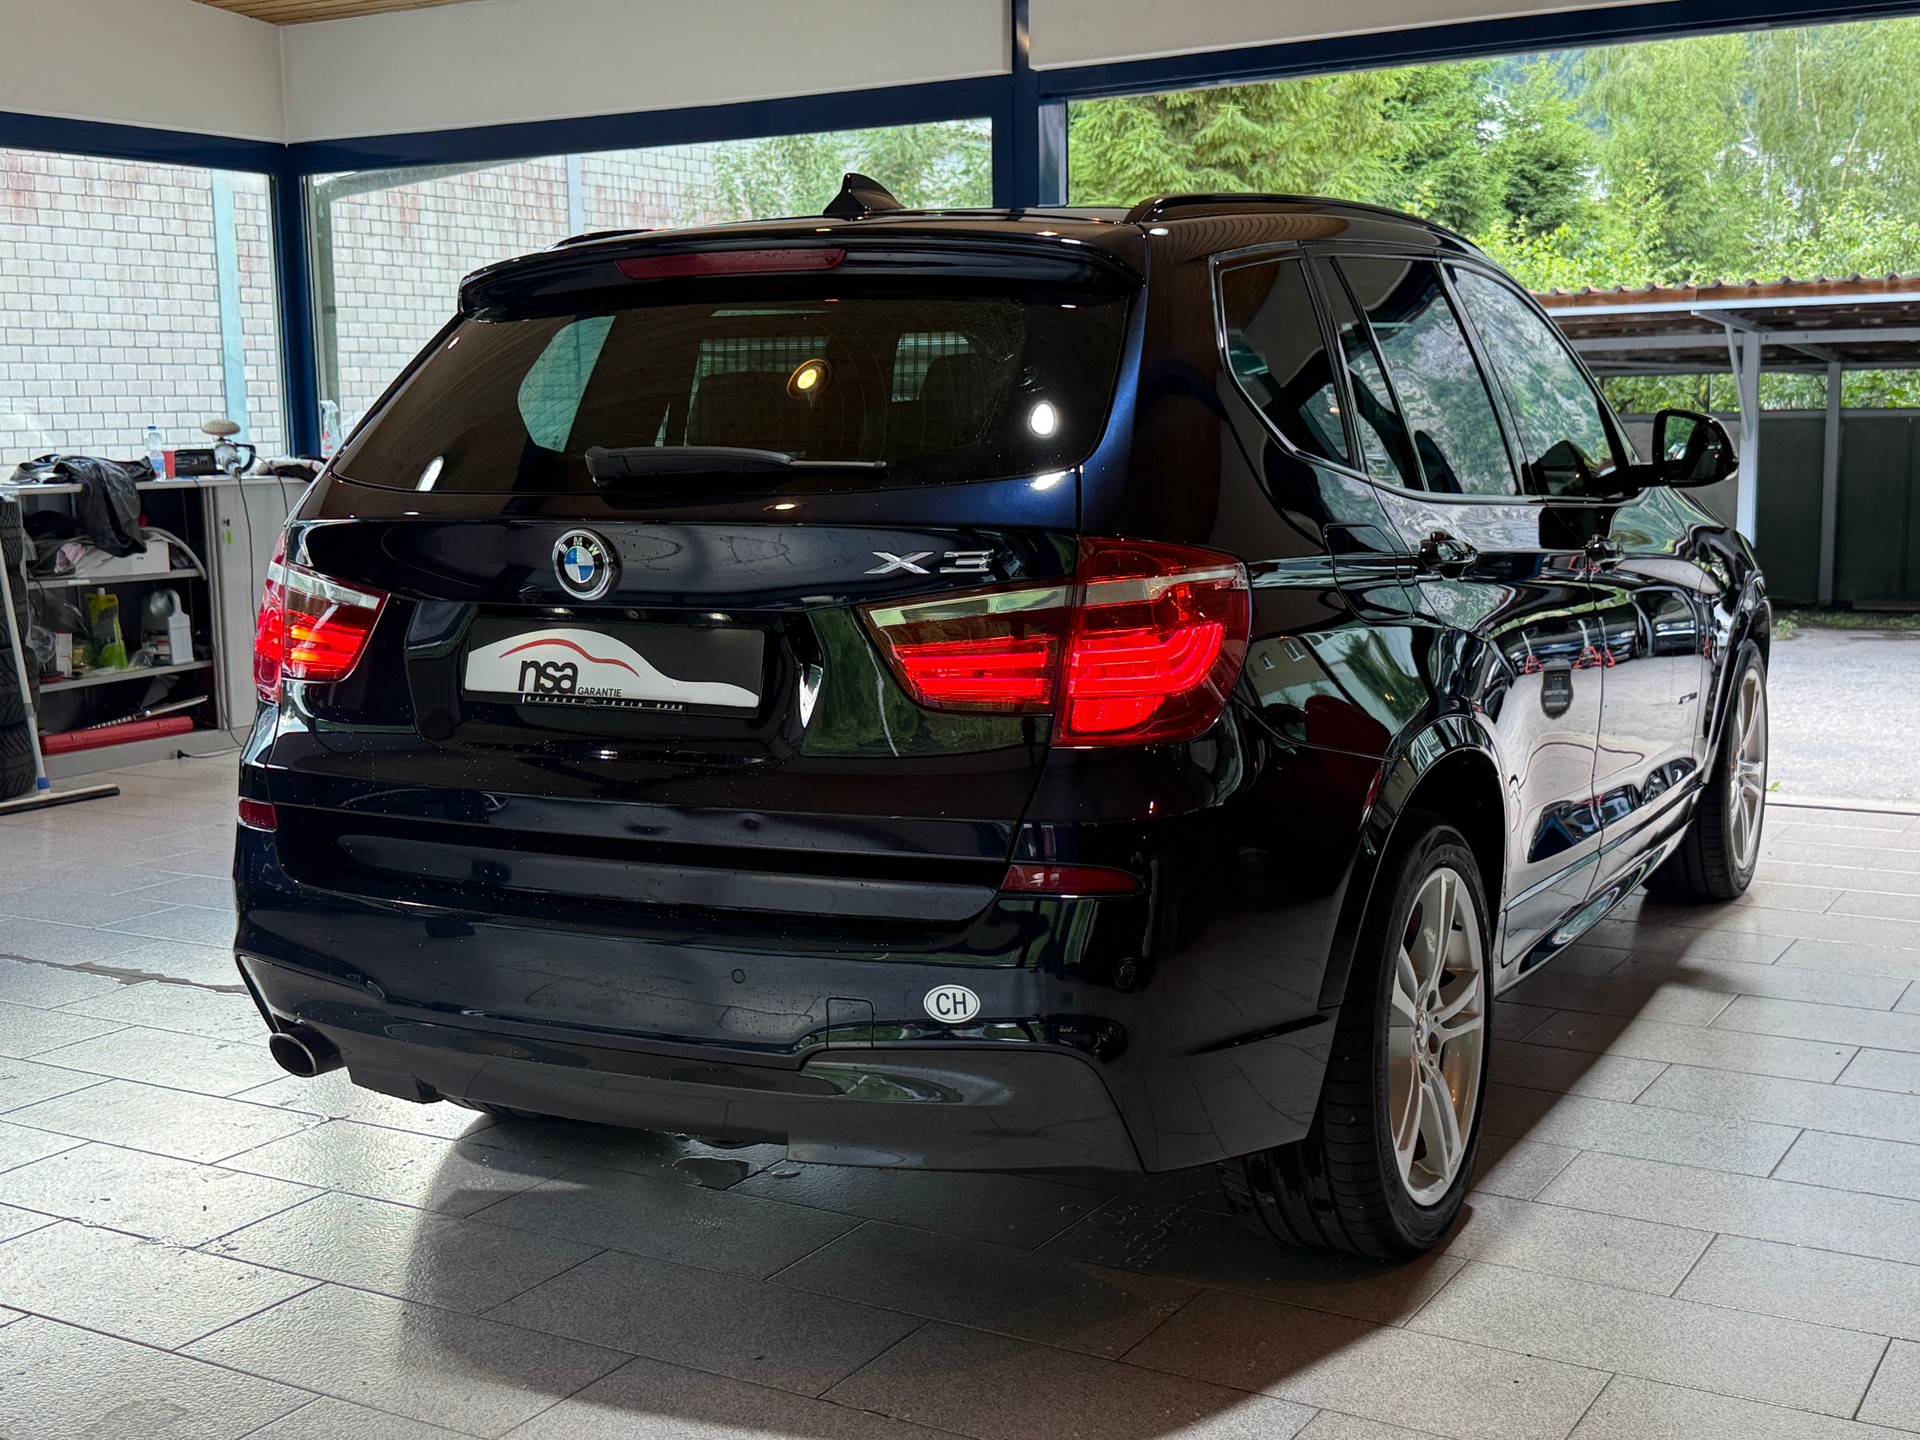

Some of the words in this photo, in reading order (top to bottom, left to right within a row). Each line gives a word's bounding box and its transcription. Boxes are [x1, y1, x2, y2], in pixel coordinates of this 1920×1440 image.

[559, 536, 600, 557] BMW
[864, 549, 995, 574] X3
[518, 660, 579, 695] nsa
[577, 686, 623, 698] GARANTIE
[935, 992, 968, 1016] CH
